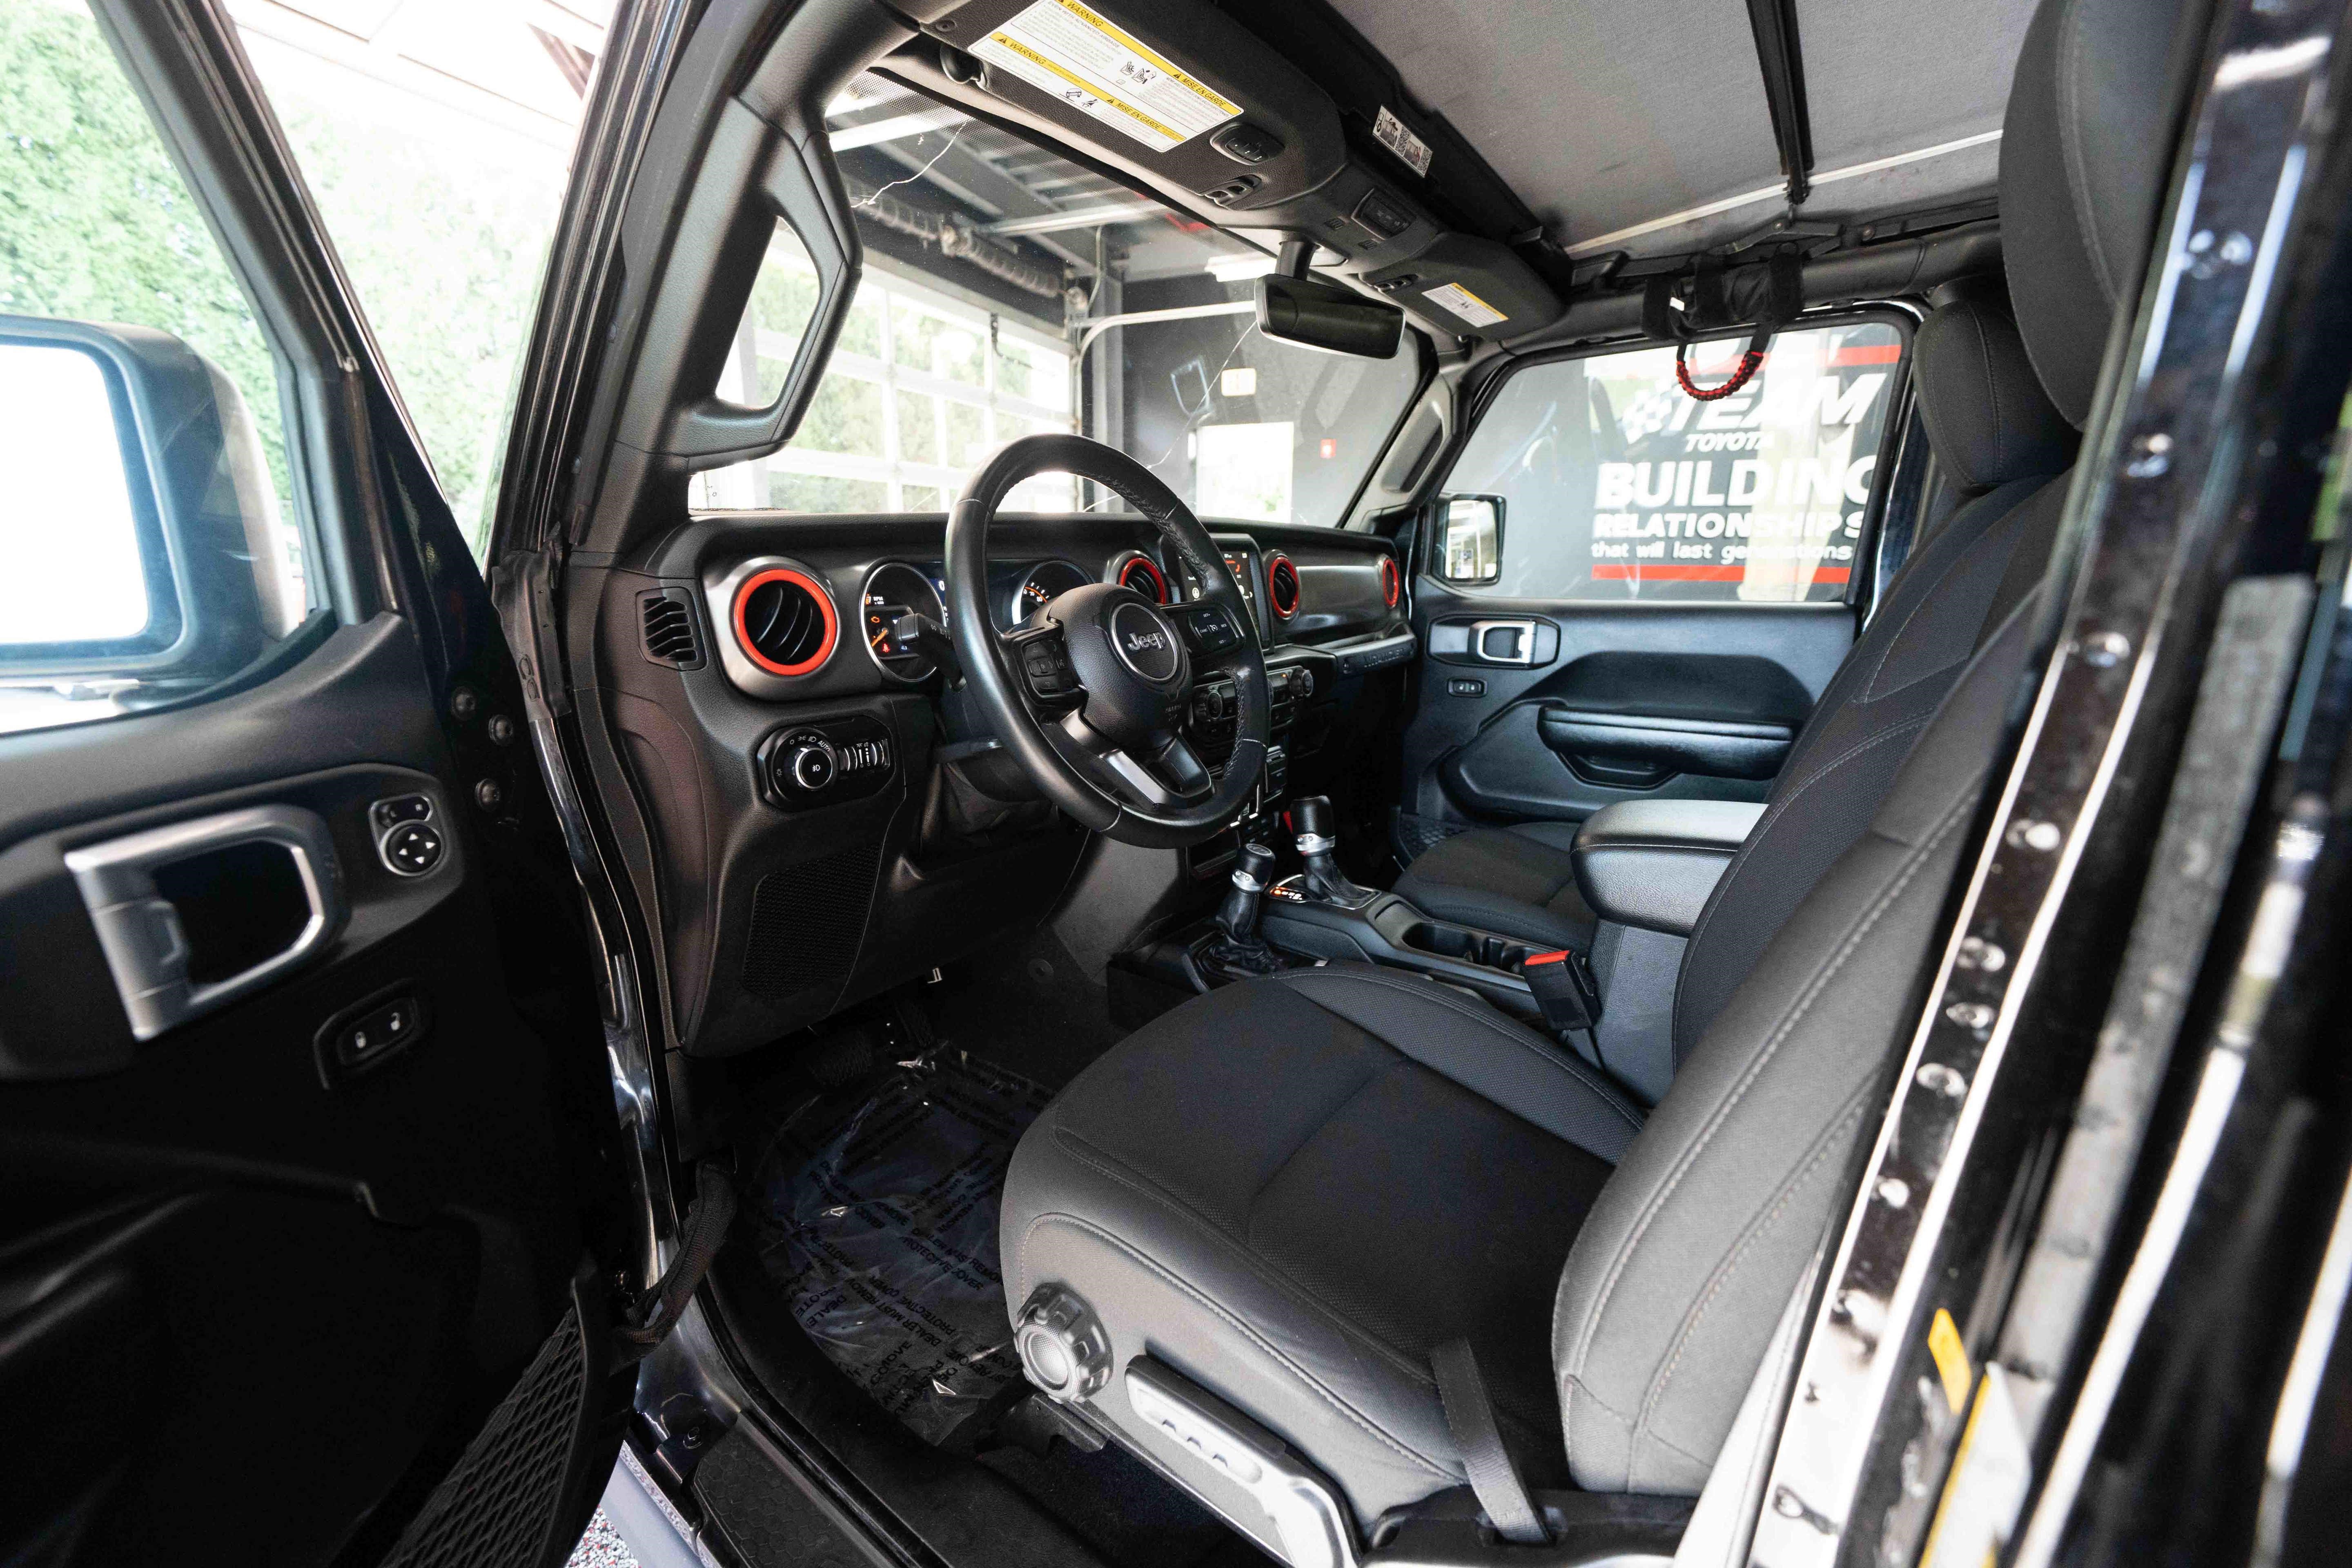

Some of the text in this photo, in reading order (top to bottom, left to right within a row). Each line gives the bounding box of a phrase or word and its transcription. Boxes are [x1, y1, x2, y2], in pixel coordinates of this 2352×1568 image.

[1067, 1, 1103, 27] WARNING
[1010, 42, 1046, 65] WARNING
[1182, 78, 1198, 89] MISE
[1205, 93, 1227, 107] GARDE
[1116, 103, 1133, 113] MISE
[1140, 116, 1163, 129] GARDE
[1668, 373, 1887, 431] TEAM
[1685, 432, 1775, 452] TOYOTA
[1591, 541, 1853, 565] that will last generations
[1127, 632, 1165, 650] Jeep
[817, 739, 831, 753] AUTO
